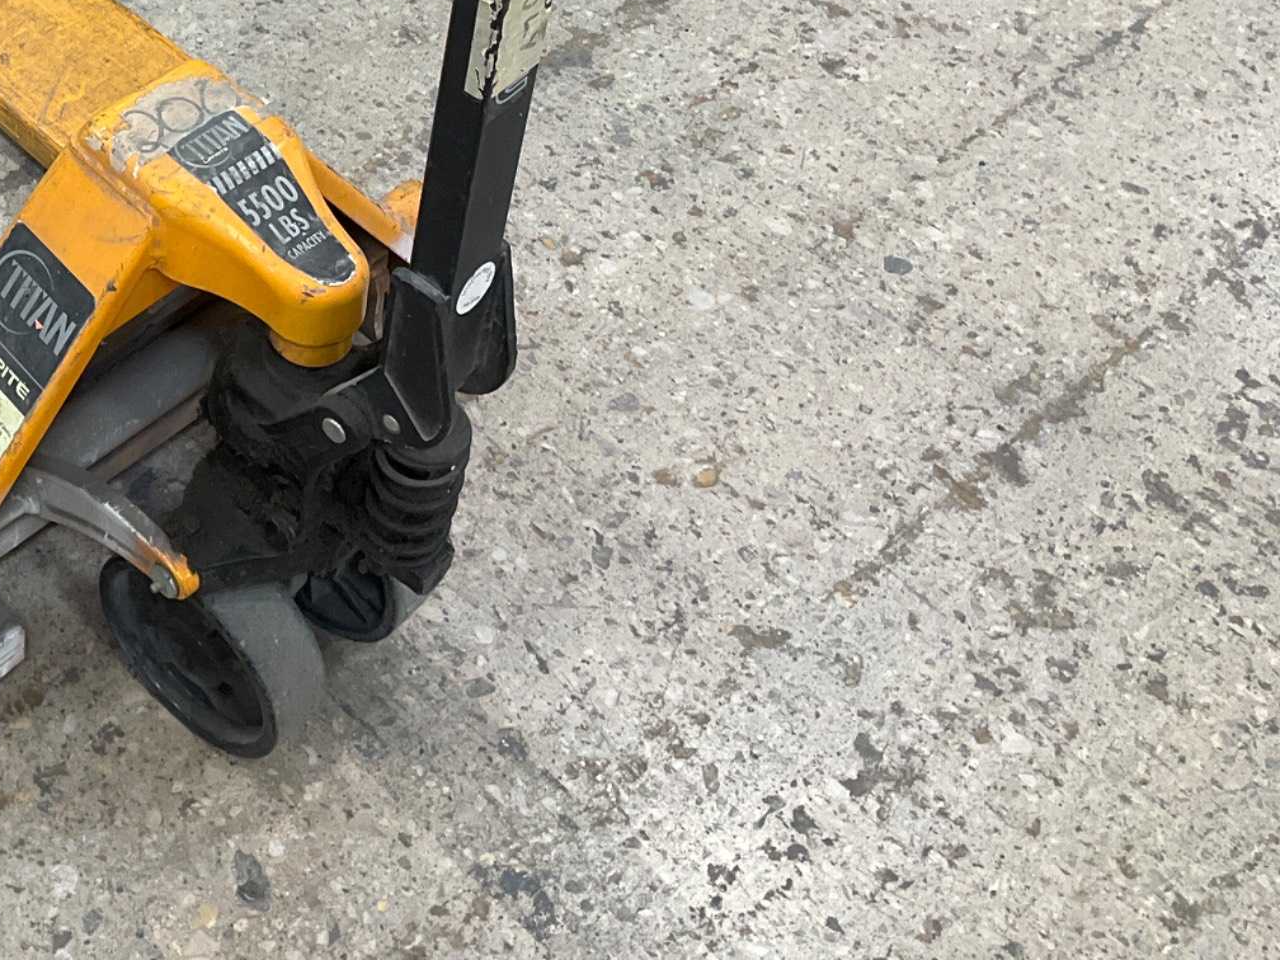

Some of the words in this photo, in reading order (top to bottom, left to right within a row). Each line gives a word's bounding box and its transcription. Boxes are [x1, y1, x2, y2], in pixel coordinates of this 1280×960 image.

[179, 115, 250, 164] TITAN
[237, 175, 299, 227] 5500
[269, 207, 311, 244] LBS
[287, 229, 328, 259] CAPACITY
[0, 258, 77, 357] TITAN
